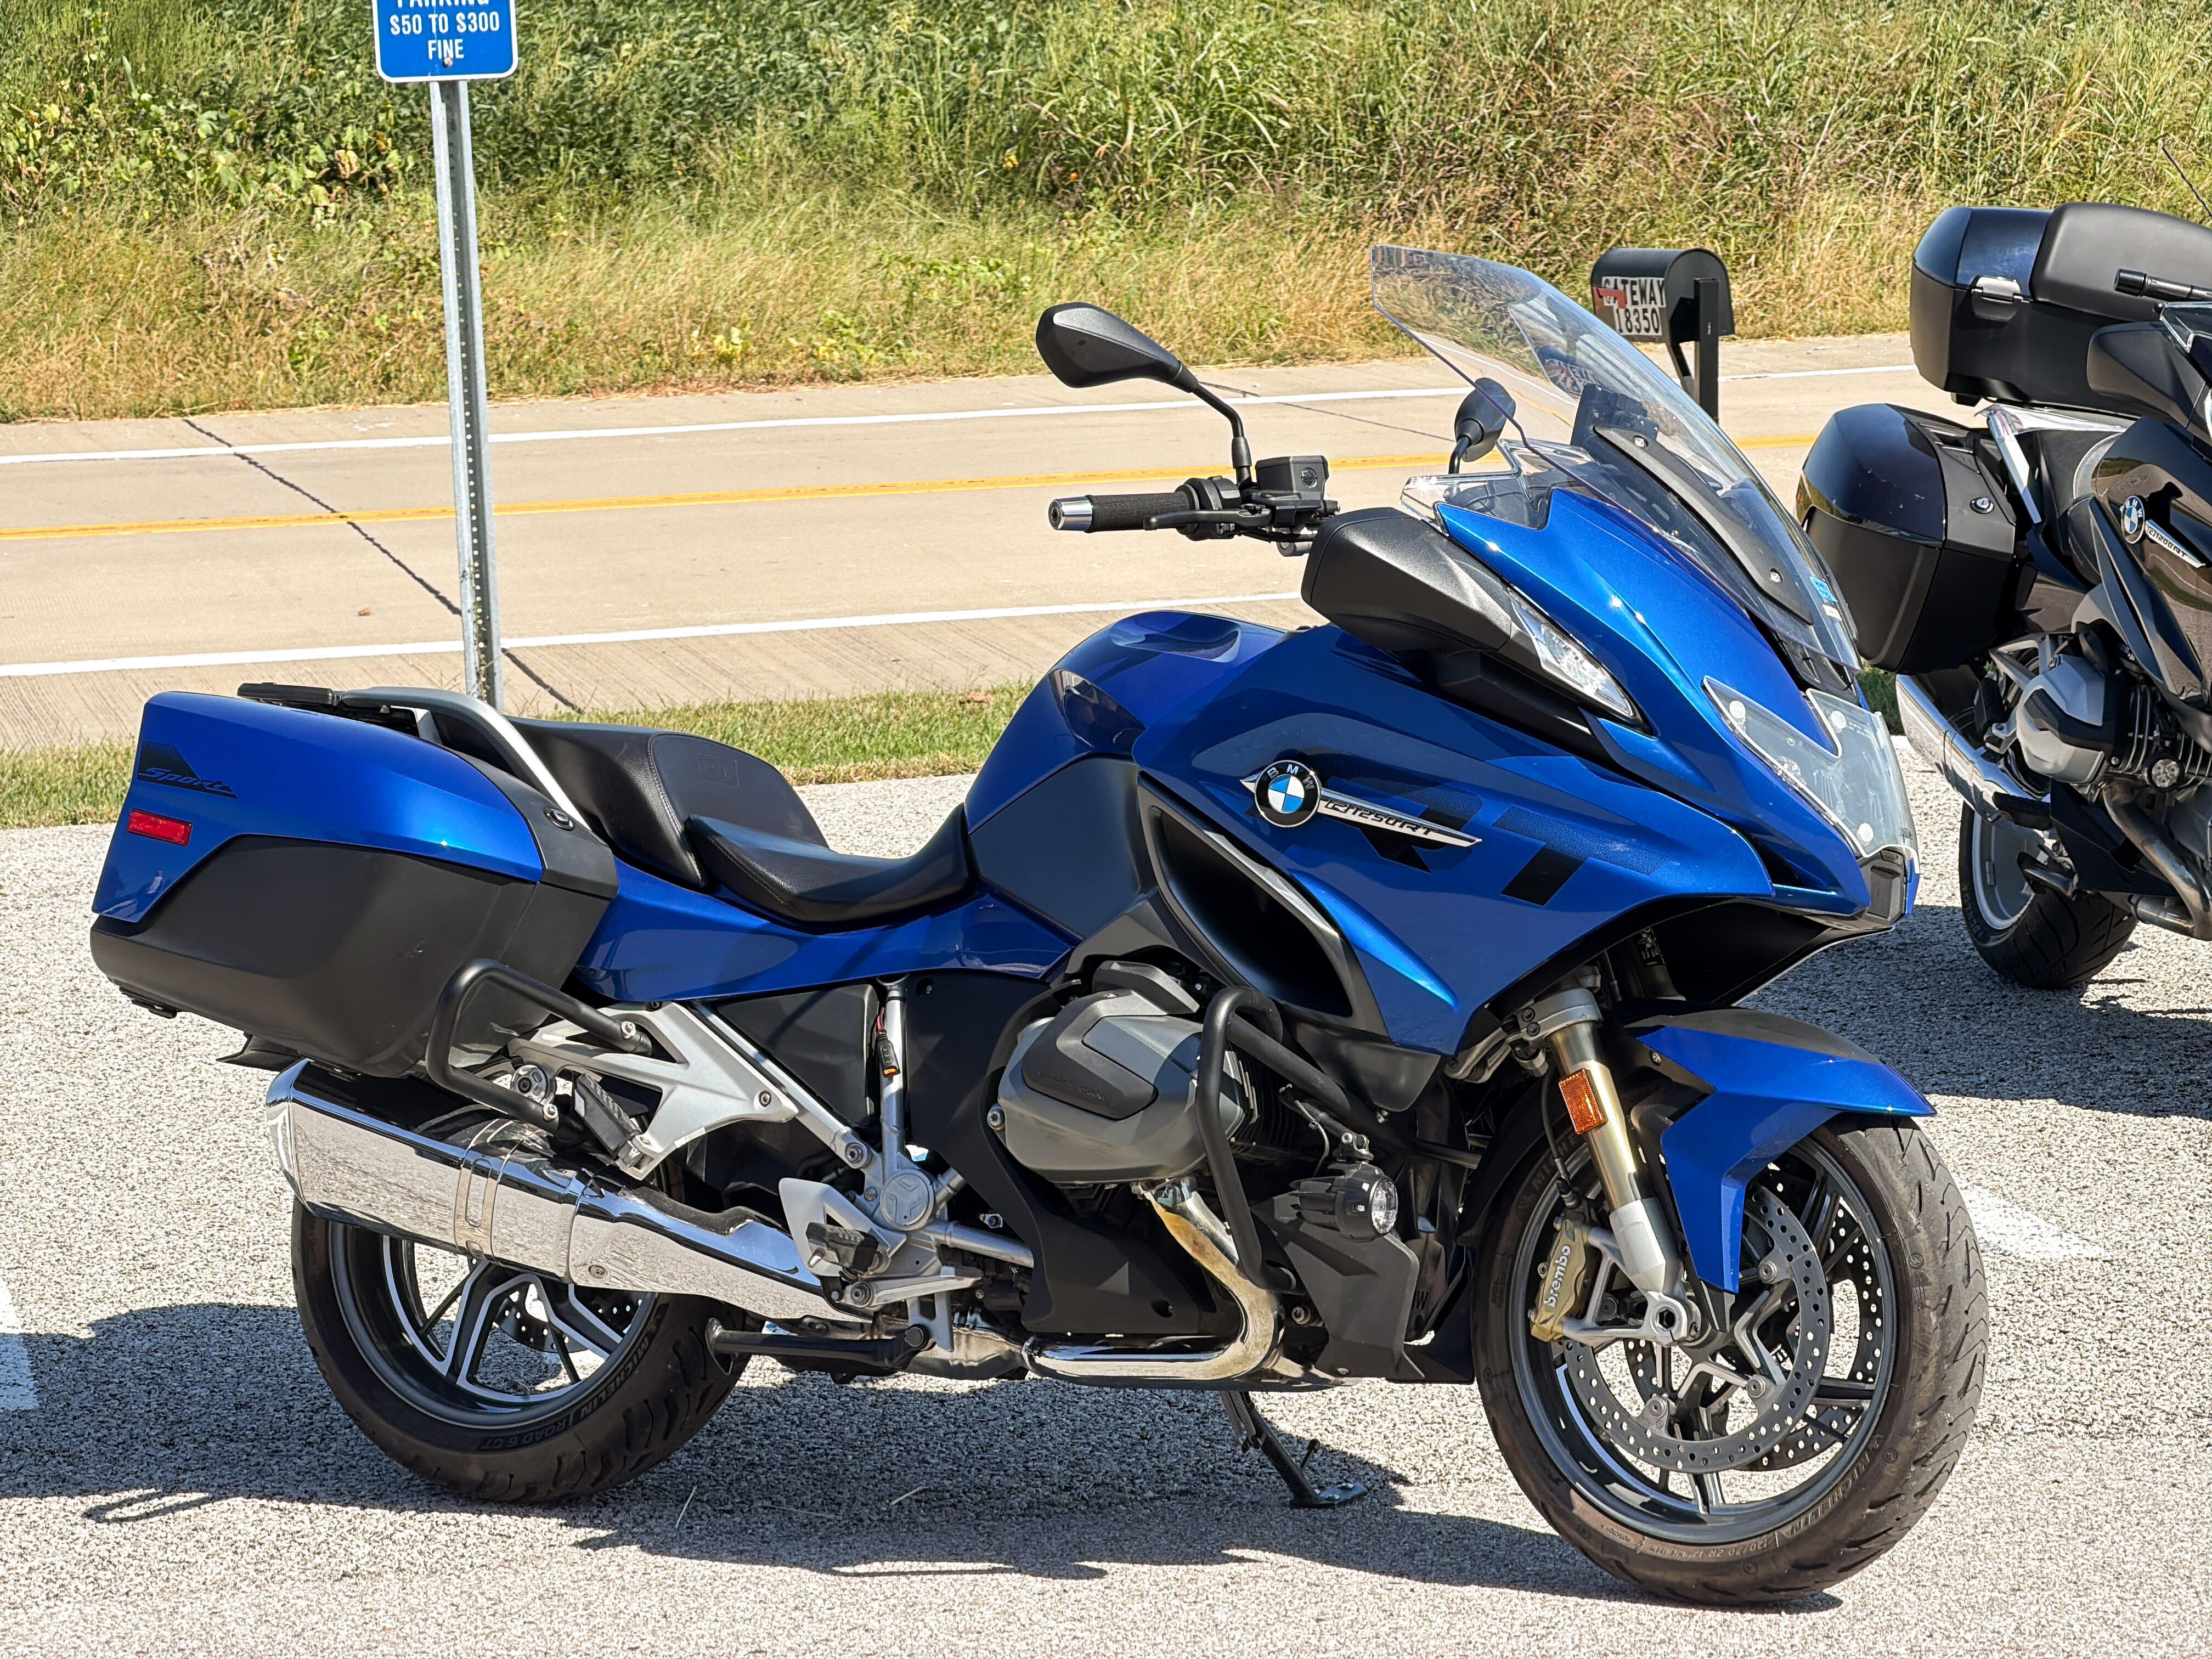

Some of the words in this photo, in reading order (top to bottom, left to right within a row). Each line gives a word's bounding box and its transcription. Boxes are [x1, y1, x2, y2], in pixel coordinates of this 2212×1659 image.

[390, 14, 422, 35] $50
[428, 13, 449, 33] TO
[456, 12, 500, 33] $300
[428, 39, 465, 60] FINE
[1616, 307, 1660, 334] 18350
[2125, 498, 2143, 518] BMW
[1267, 763, 1315, 791] BMW
[1544, 1245, 1571, 1308] brembo
[580, 1337, 650, 1419] MICHELIN
[508, 1436, 518, 1447] 6
[522, 1418, 567, 1443] ROAD
